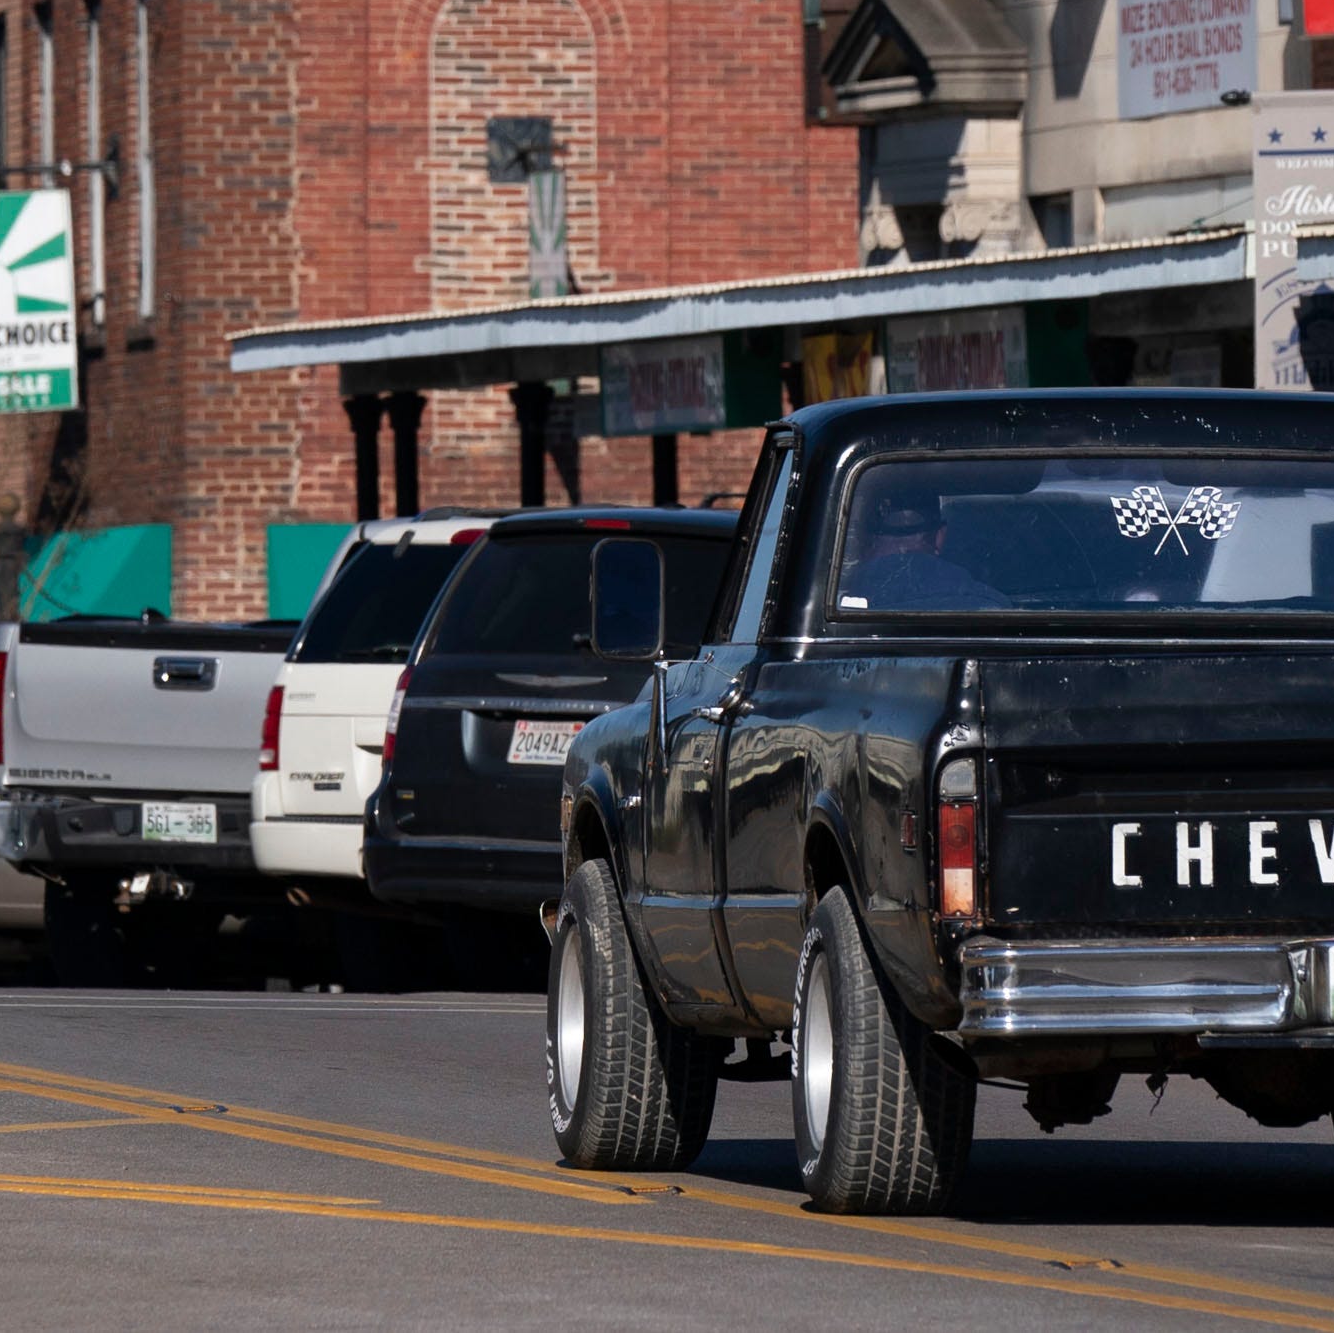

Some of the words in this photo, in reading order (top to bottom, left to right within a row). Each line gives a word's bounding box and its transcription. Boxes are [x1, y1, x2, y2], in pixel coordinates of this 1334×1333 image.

[1204, 23, 1243, 56] BONDS
[515, 731, 576, 755] 2049AZ
[8, 767, 87, 783] SIERRA
